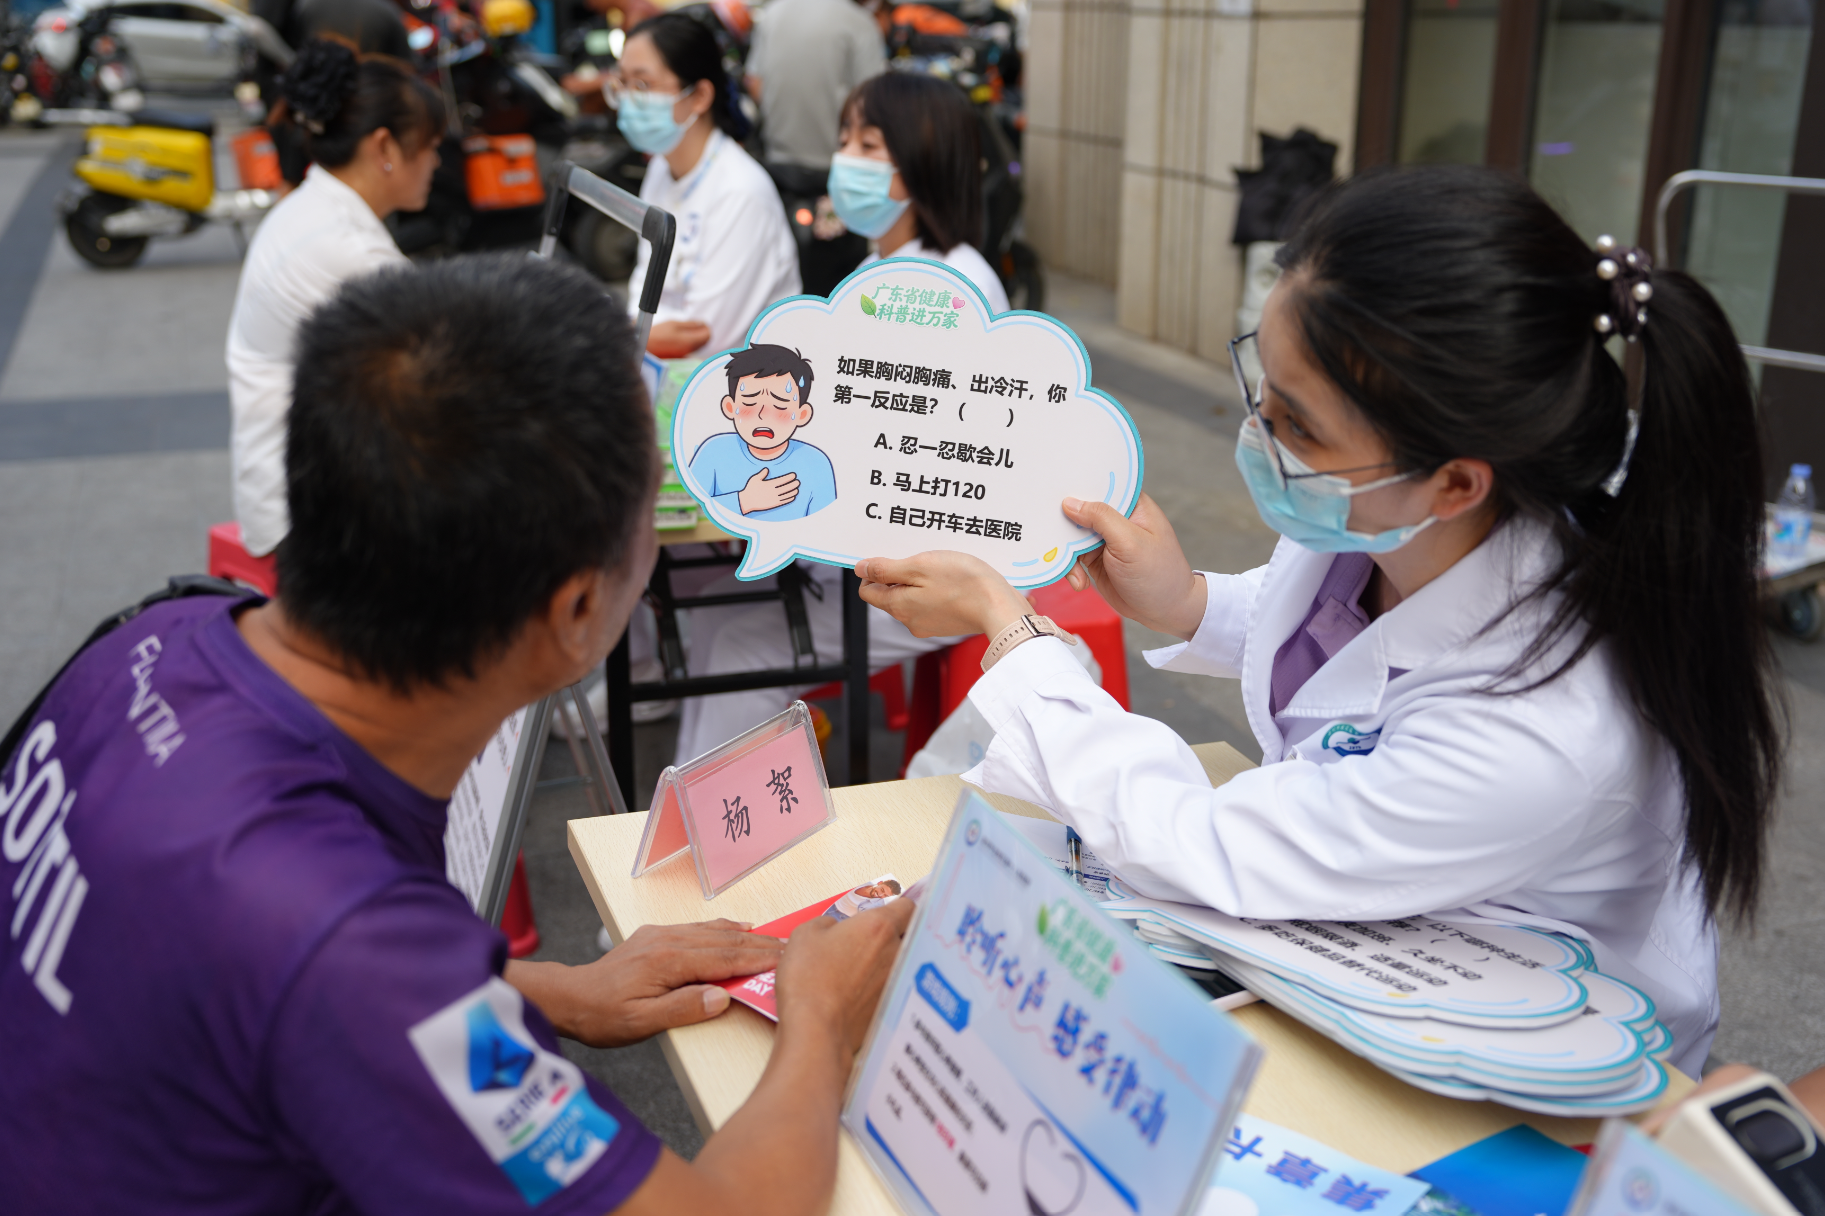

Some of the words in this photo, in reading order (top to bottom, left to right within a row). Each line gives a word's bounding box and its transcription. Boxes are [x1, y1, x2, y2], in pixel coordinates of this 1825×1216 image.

[872, 282, 952, 310] 广东省健康
[876, 303, 961, 331] 科普进万家
[836, 356, 1068, 405] 如果胸闷胸痛、出冷汗，你
[899, 436, 1015, 469] 忍一忍歇会儿
[892, 472, 987, 501] 马上打120
[888, 505, 1023, 543] 自己开车去医院
[742, 978, 774, 997] DAY
